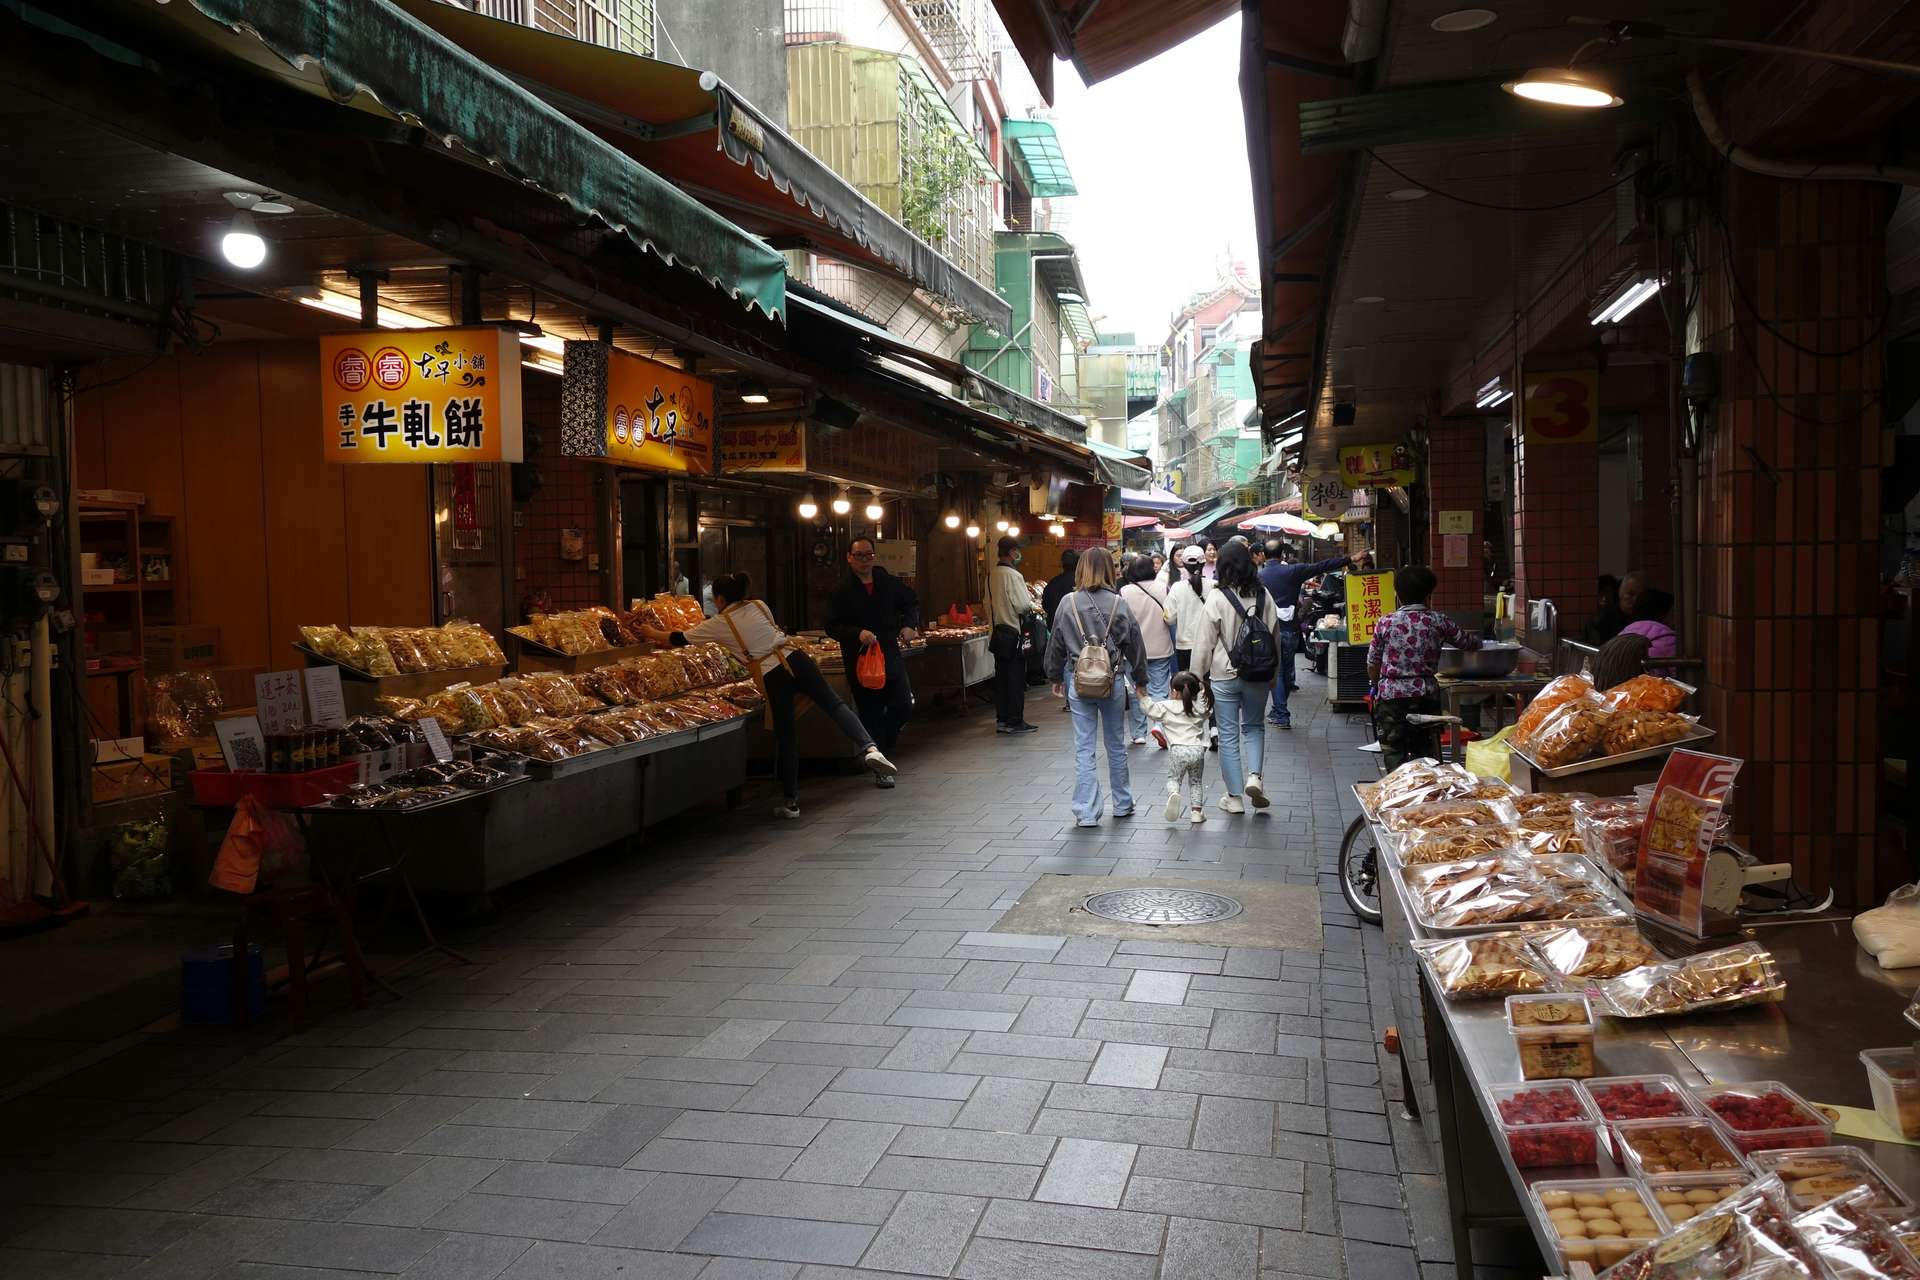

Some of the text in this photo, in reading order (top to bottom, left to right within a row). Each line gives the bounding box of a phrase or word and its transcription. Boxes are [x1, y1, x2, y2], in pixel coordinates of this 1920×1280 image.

[339, 398, 484, 448] 手工 牛軋餅
[1529, 377, 1591, 438] 3
